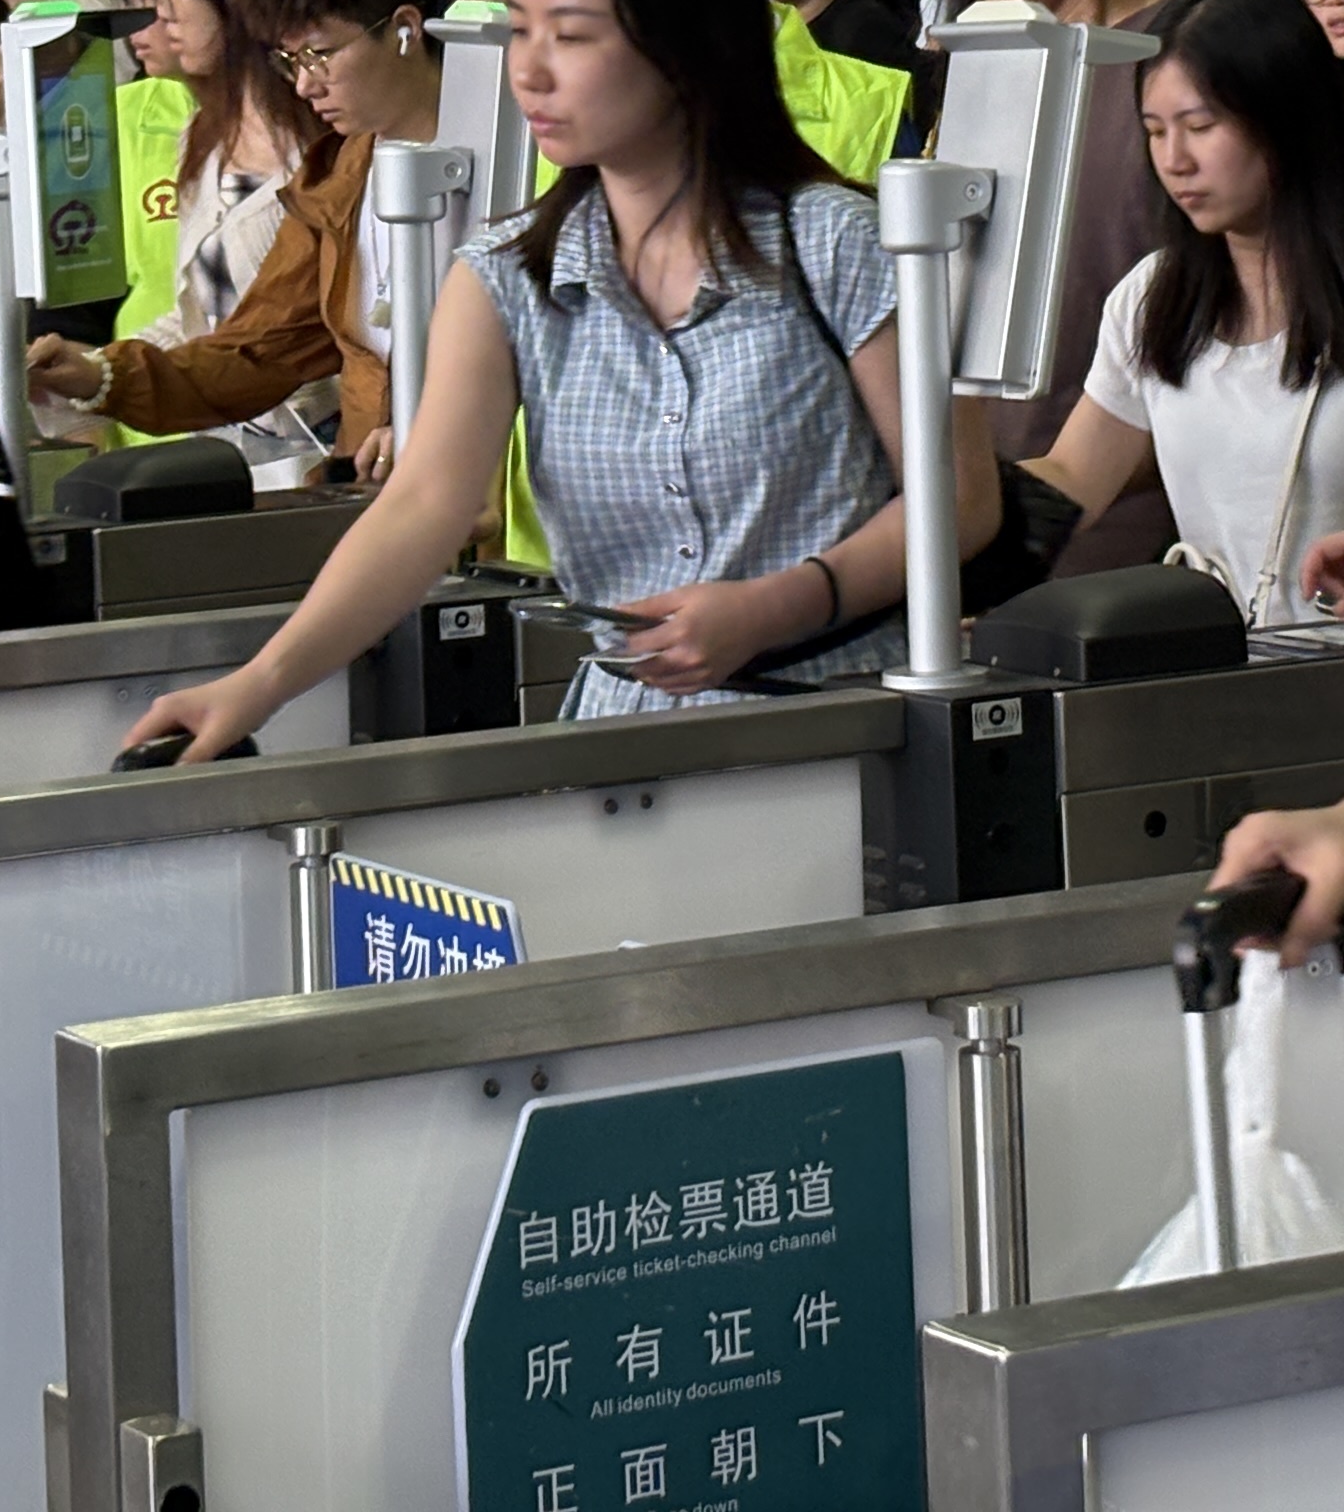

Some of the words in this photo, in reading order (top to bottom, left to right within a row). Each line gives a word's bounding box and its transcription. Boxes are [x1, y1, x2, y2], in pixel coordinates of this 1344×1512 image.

[519, 1160, 834, 1270] 自助检票通道
[522, 1265, 627, 1298] Self-service
[633, 1240, 763, 1278] ticket-checking
[769, 1225, 837, 1253] channel
[526, 1290, 840, 1401] 所有证件
[591, 1399, 613, 1420] All
[618, 1386, 683, 1413] identity
[686, 1368, 782, 1400] documents
[533, 1410, 844, 1512] 正面朝下
